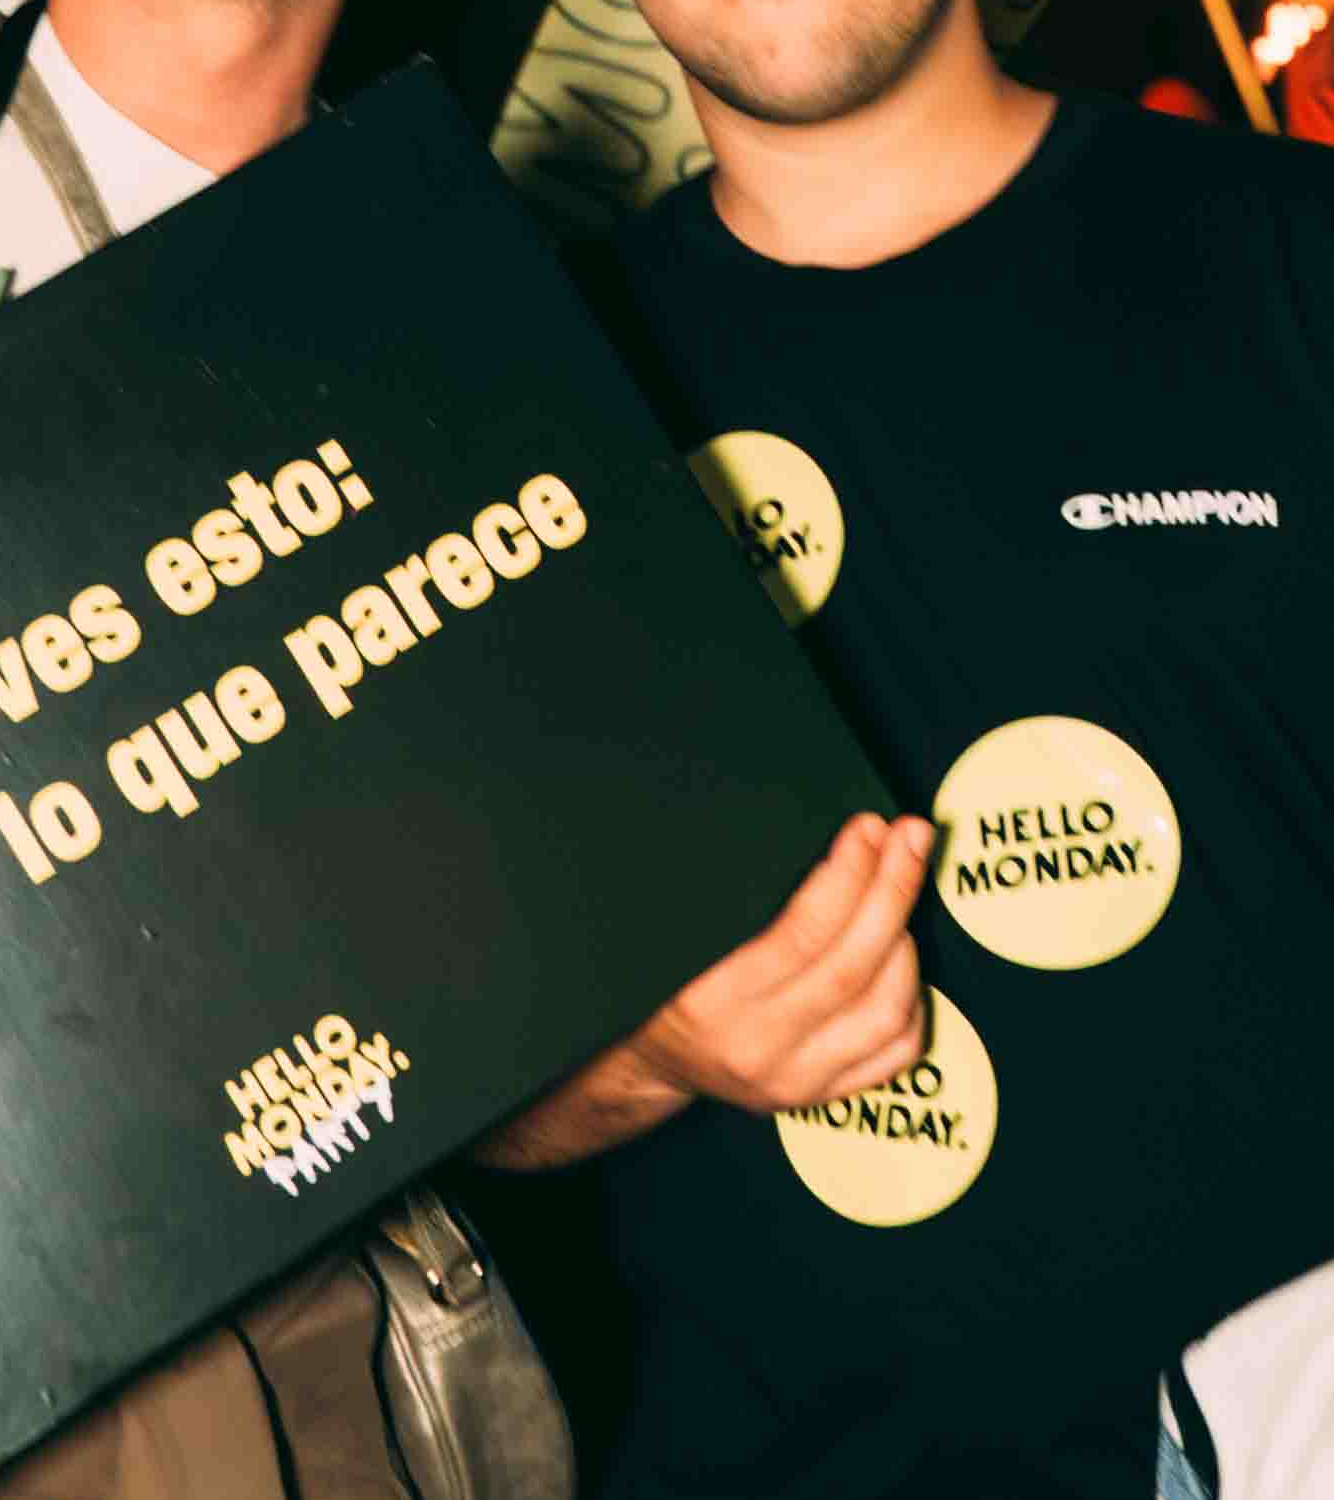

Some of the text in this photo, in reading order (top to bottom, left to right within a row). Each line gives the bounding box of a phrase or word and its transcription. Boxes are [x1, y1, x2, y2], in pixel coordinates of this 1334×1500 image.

[145, 438, 374, 616] esto:
[1061, 489, 1279, 531] CHAMPION
[106, 664, 287, 820] que
[283, 472, 588, 720] parece
[956, 839, 1154, 896] MONDAY.
[979, 801, 1115, 848] HELLO
[224, 1014, 358, 1121] HELLO
[264, 1072, 395, 1197] PARTY
